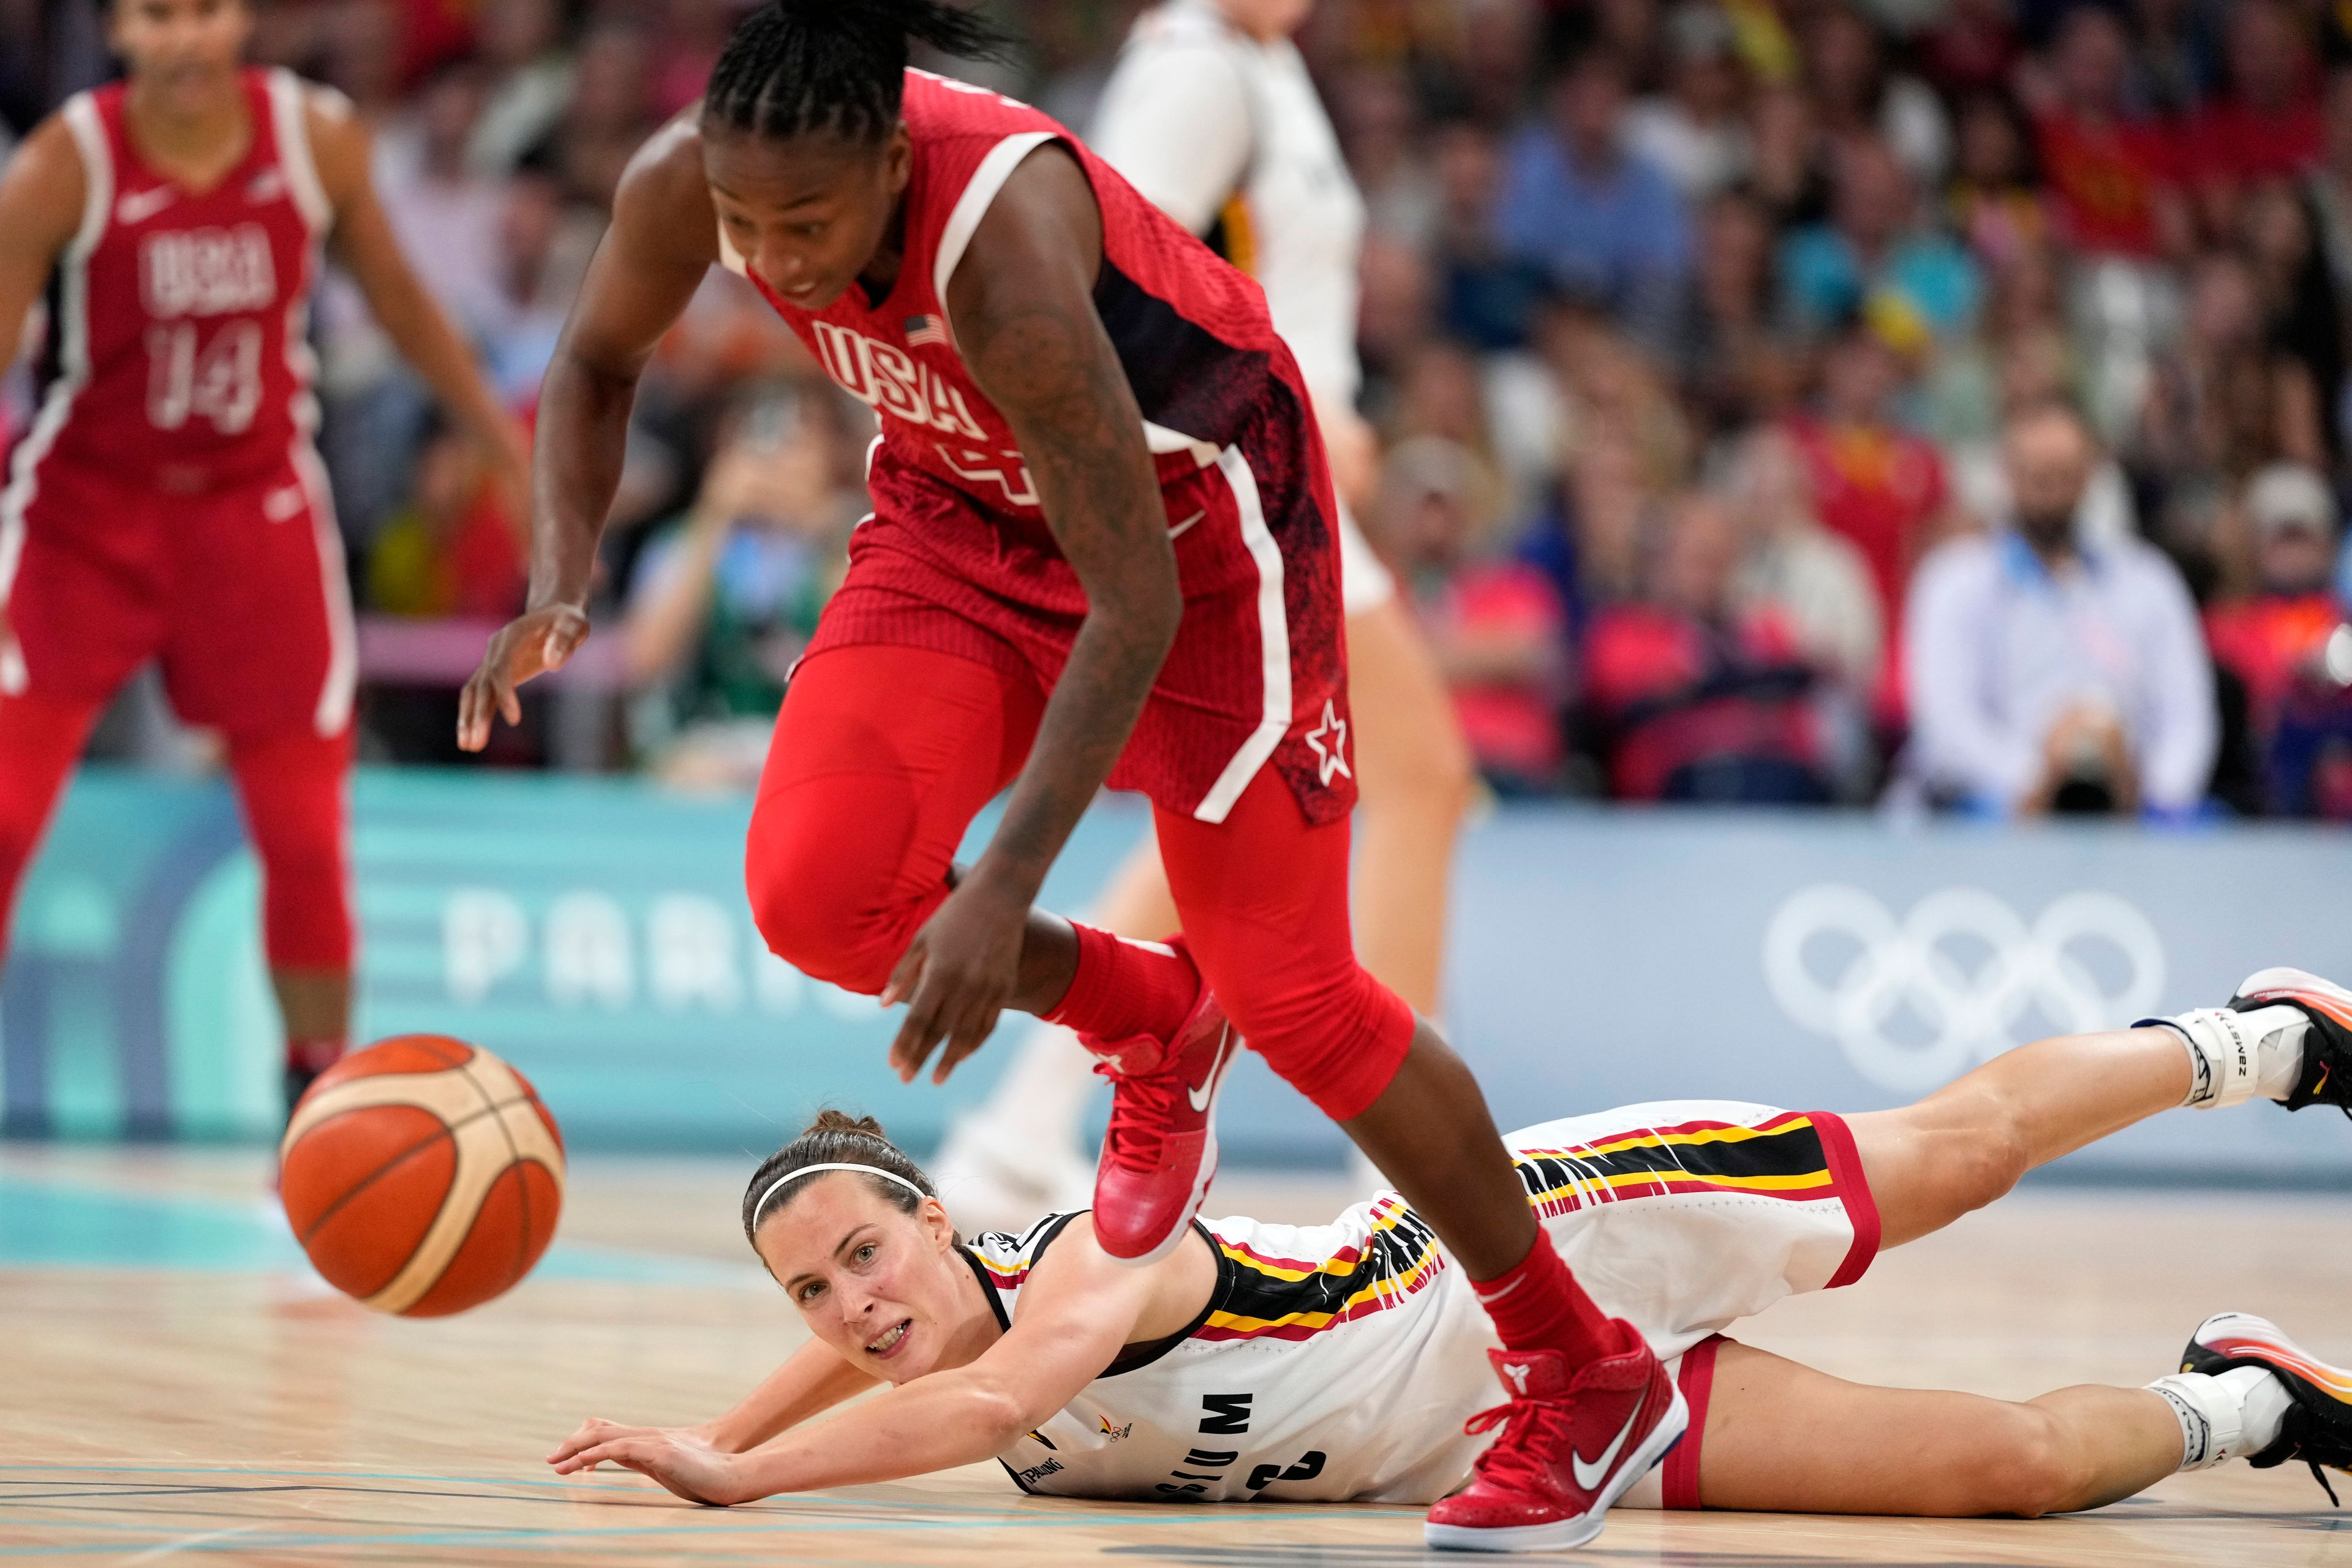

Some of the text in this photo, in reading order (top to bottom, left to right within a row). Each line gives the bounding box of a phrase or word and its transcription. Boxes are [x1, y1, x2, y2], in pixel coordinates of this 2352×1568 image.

[138, 222, 276, 317] USA
[144, 321, 263, 434] 14
[812, 320, 989, 442] USA
[446, 889, 887, 1020] PARI
